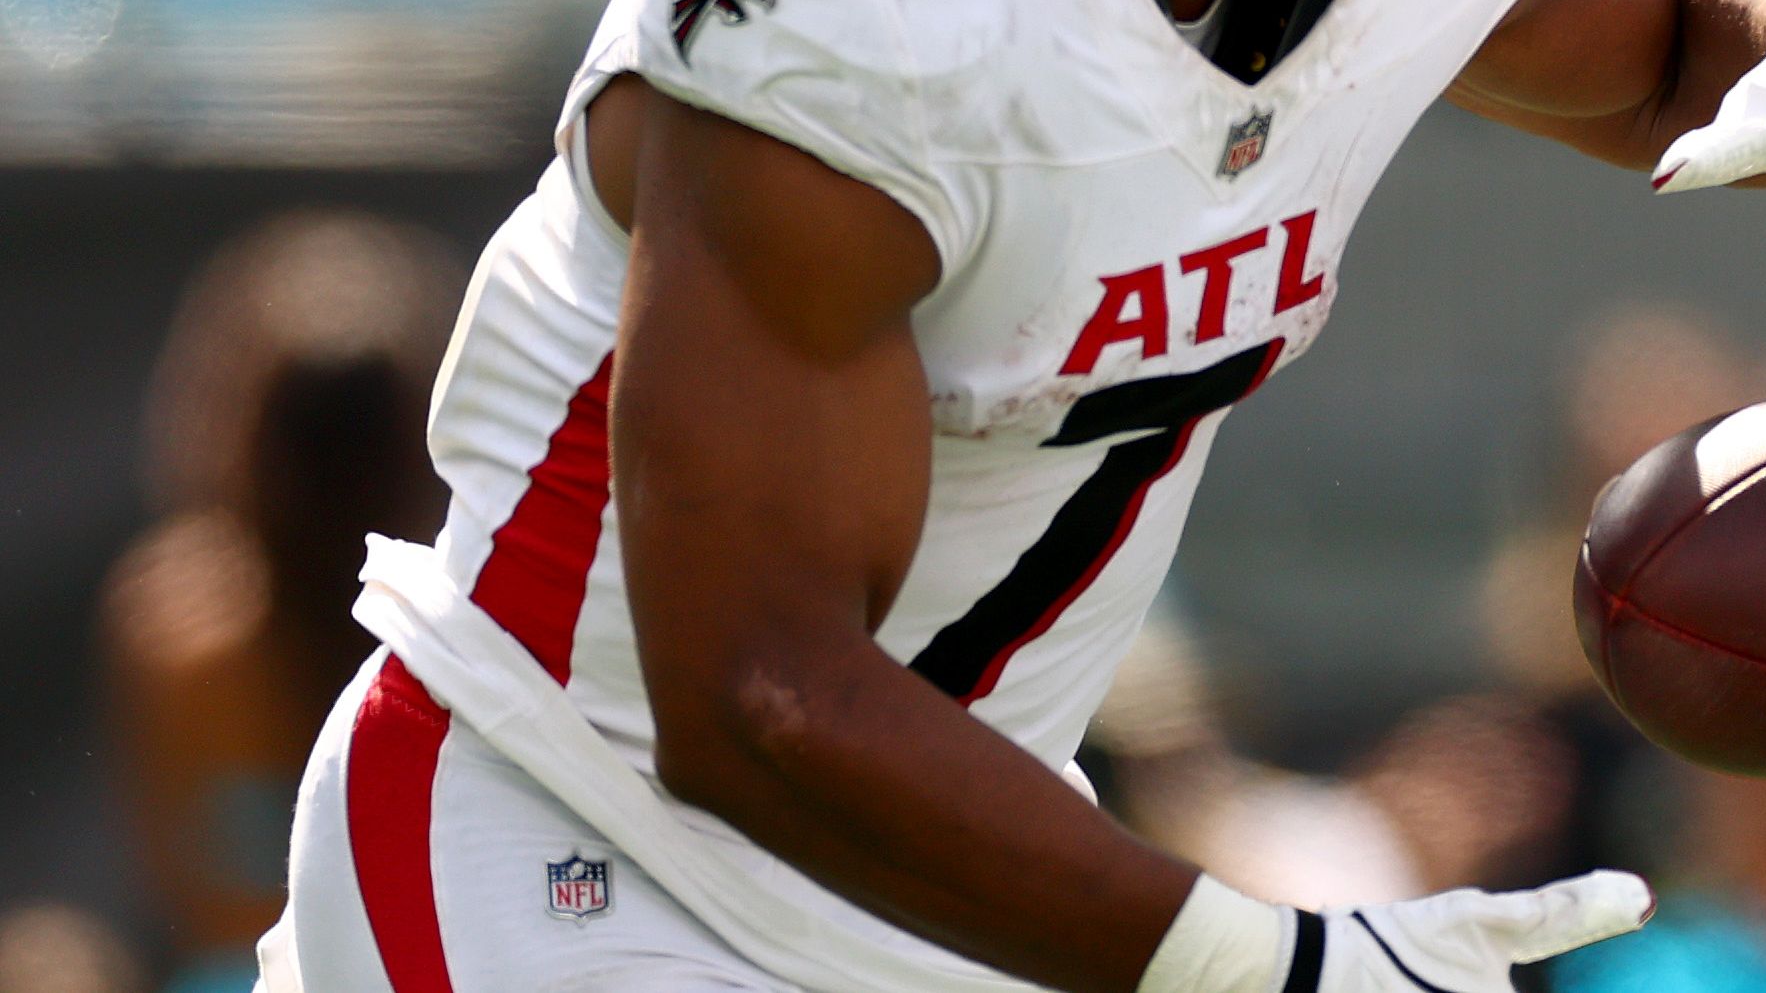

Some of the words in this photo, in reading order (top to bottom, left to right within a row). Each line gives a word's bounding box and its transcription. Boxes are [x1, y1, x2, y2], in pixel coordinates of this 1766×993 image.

[1057, 209, 1325, 376] ATL
[908, 336, 1286, 708] 7
[556, 882, 604, 910] NFL
